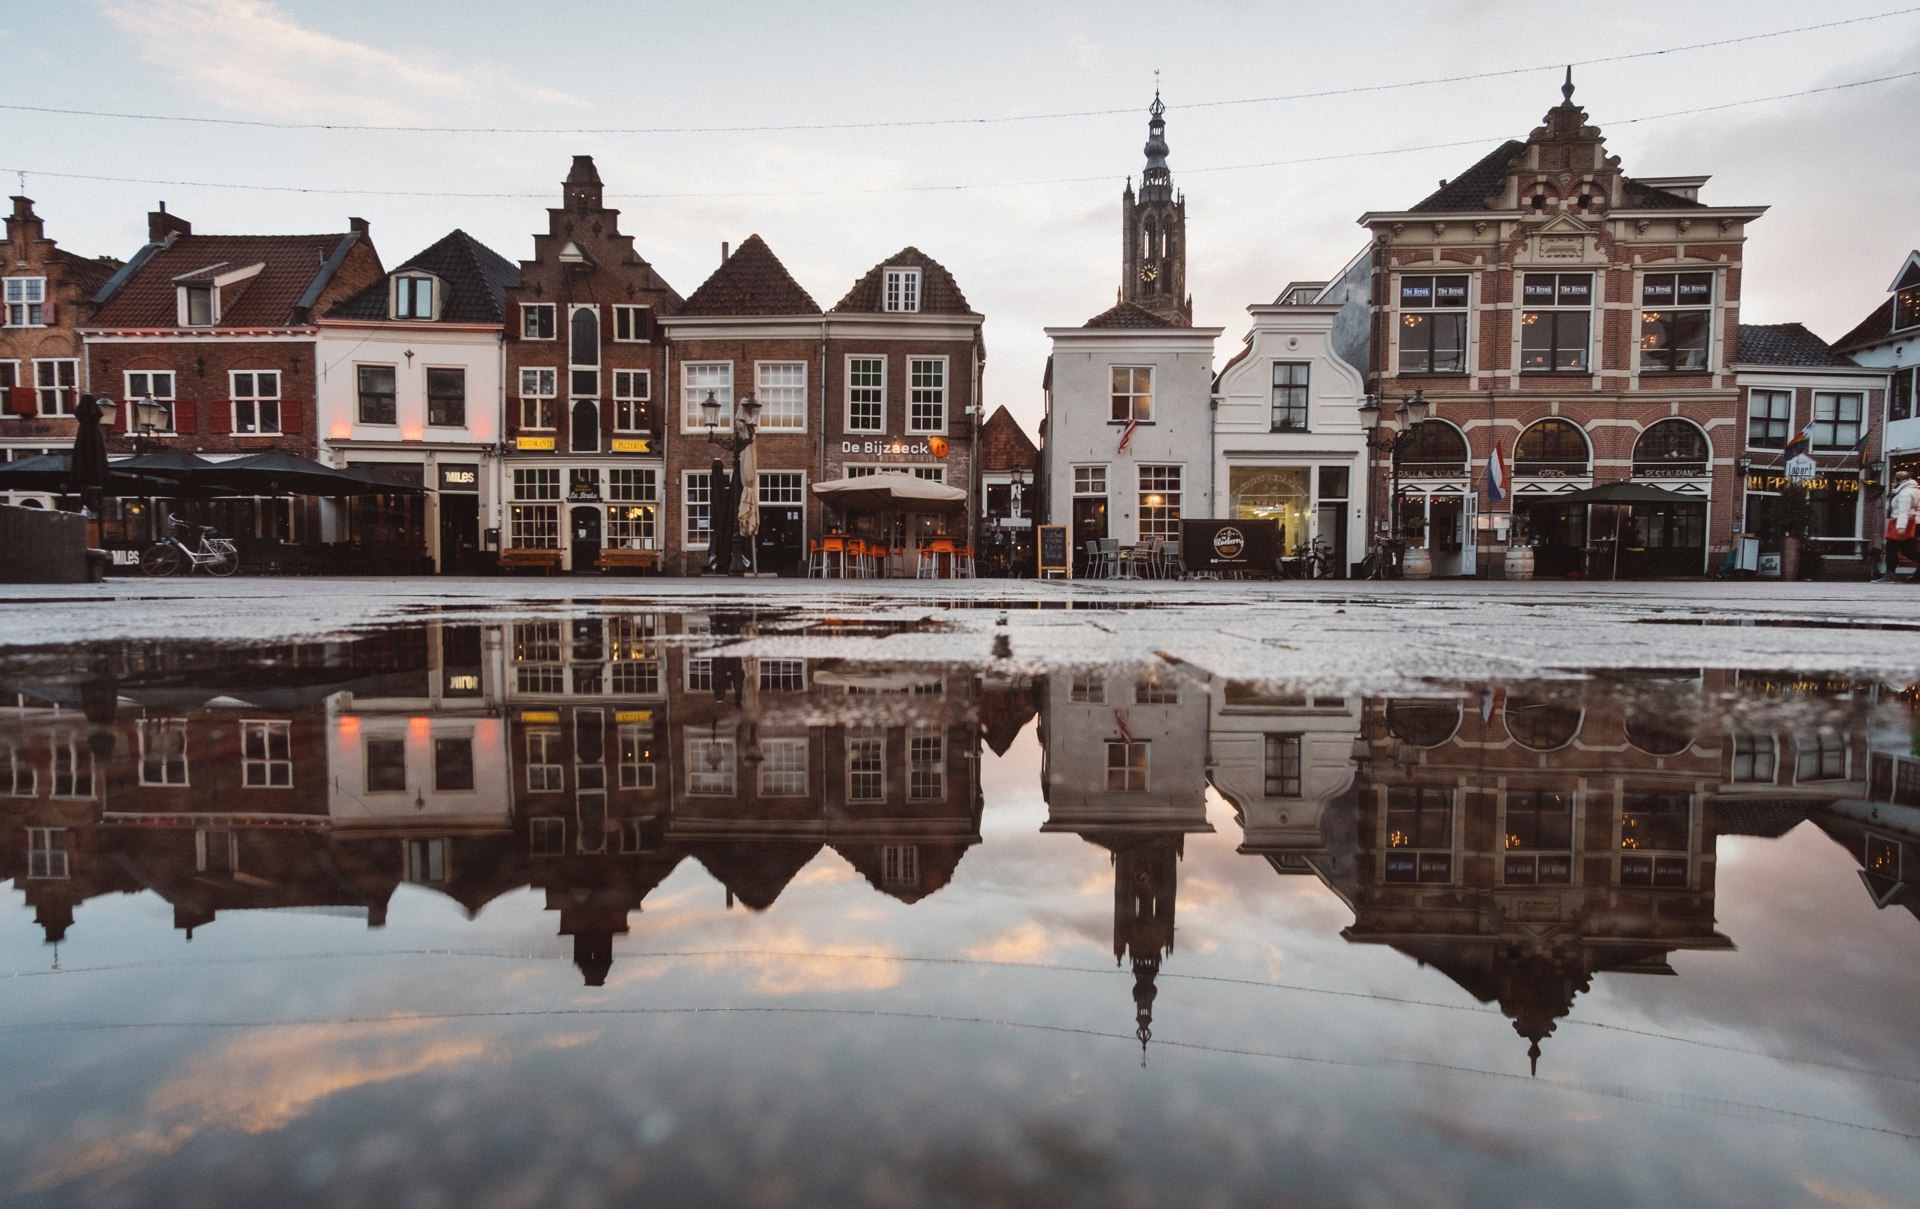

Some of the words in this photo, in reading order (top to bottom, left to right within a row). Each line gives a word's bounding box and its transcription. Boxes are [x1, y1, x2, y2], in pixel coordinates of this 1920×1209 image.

[1438, 287, 1447, 295] The
[1525, 286, 1535, 294] The
[842, 441, 860, 453] De
[864, 441, 928, 456] Bijzaeck
[1645, 469, 1701, 478] RESTAURANT
